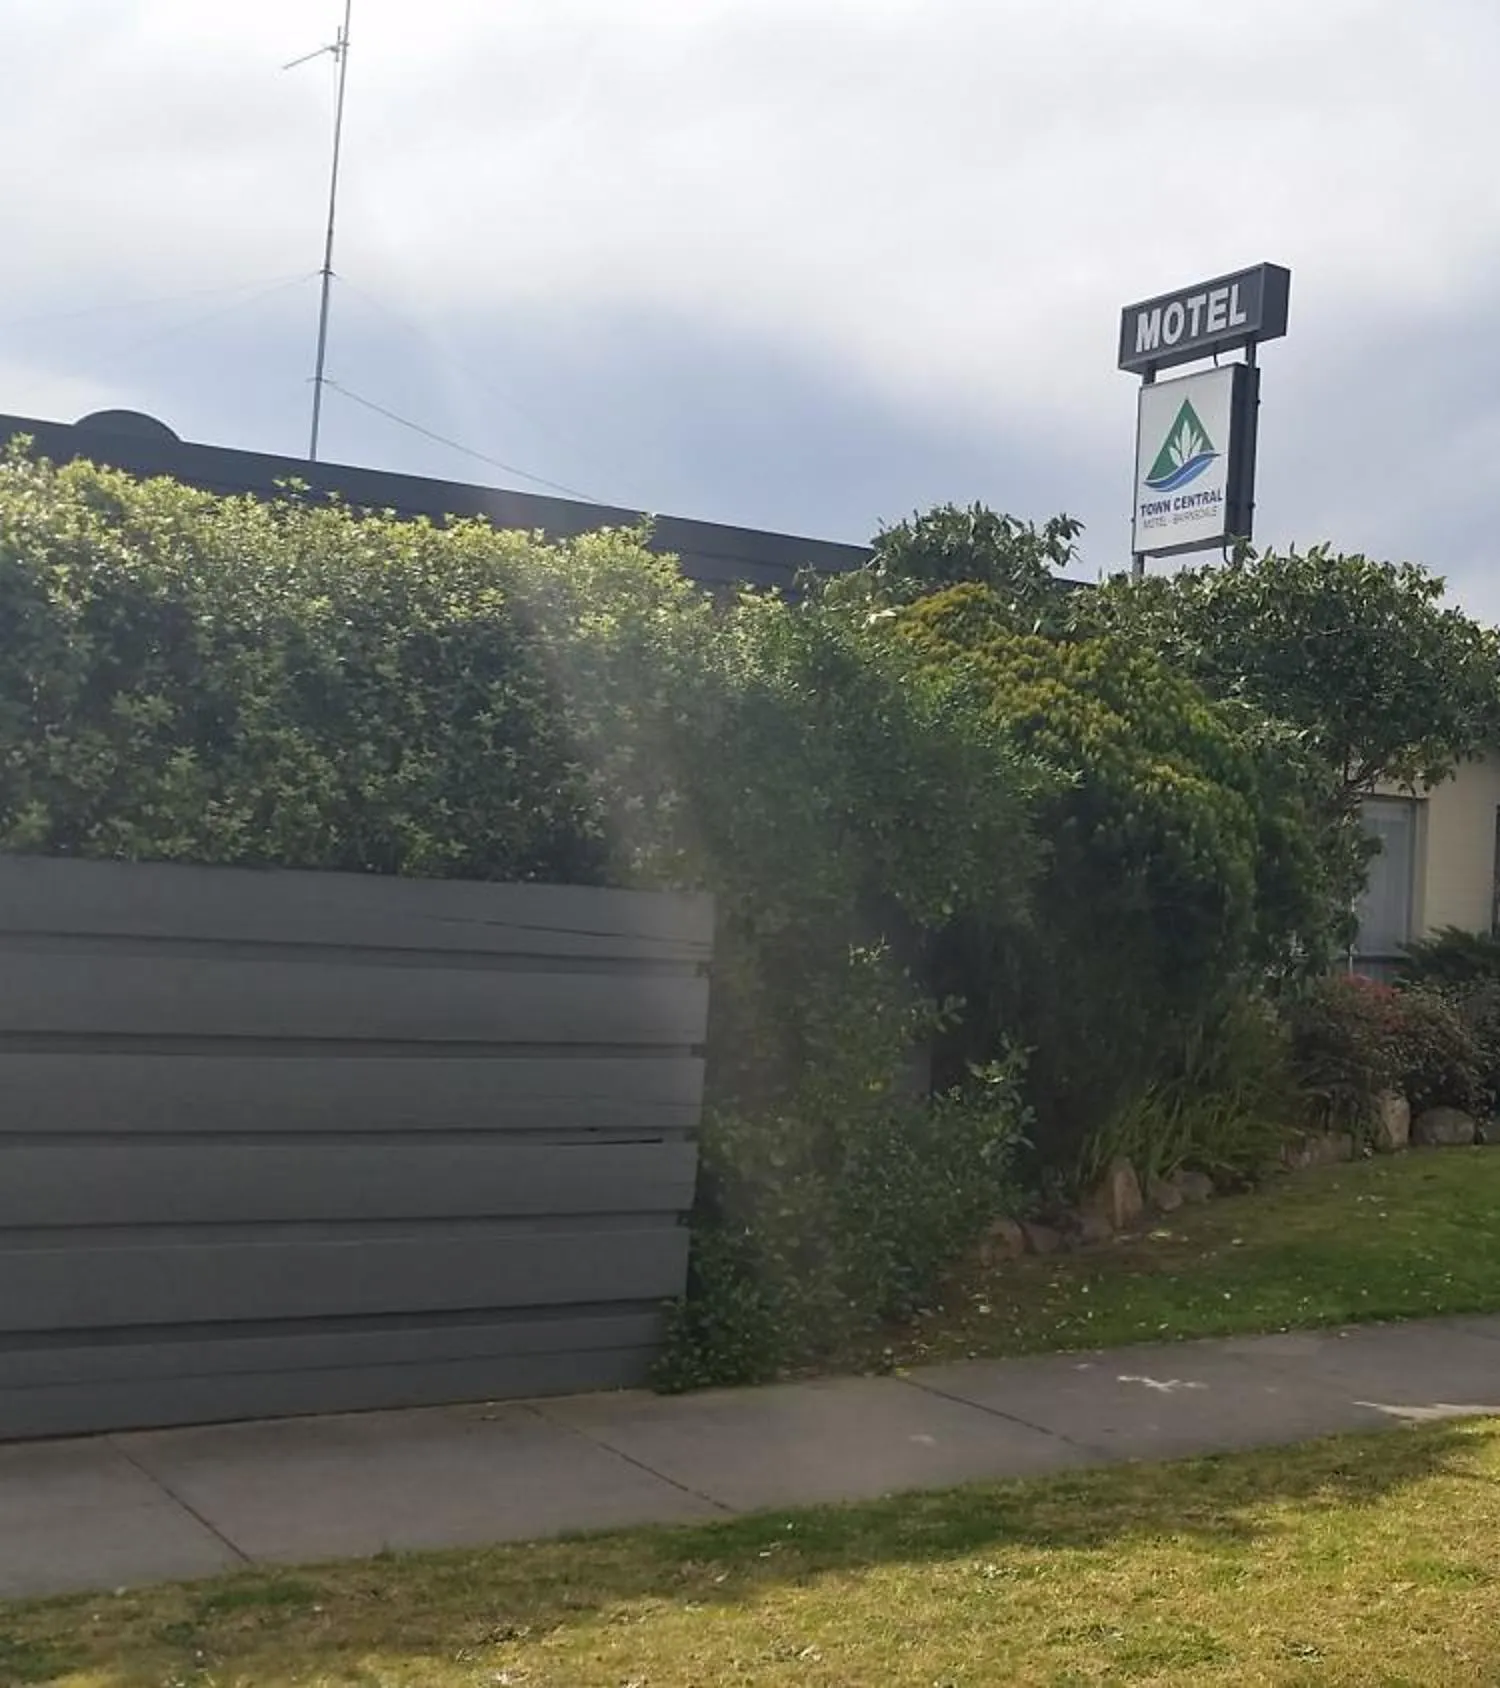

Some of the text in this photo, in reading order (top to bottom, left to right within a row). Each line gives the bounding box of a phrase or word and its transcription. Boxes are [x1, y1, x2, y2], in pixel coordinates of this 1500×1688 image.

[1136, 284, 1246, 352] MOTEL
[1140, 500, 1171, 516] TOWN
[1174, 488, 1223, 510] CENTRAL
